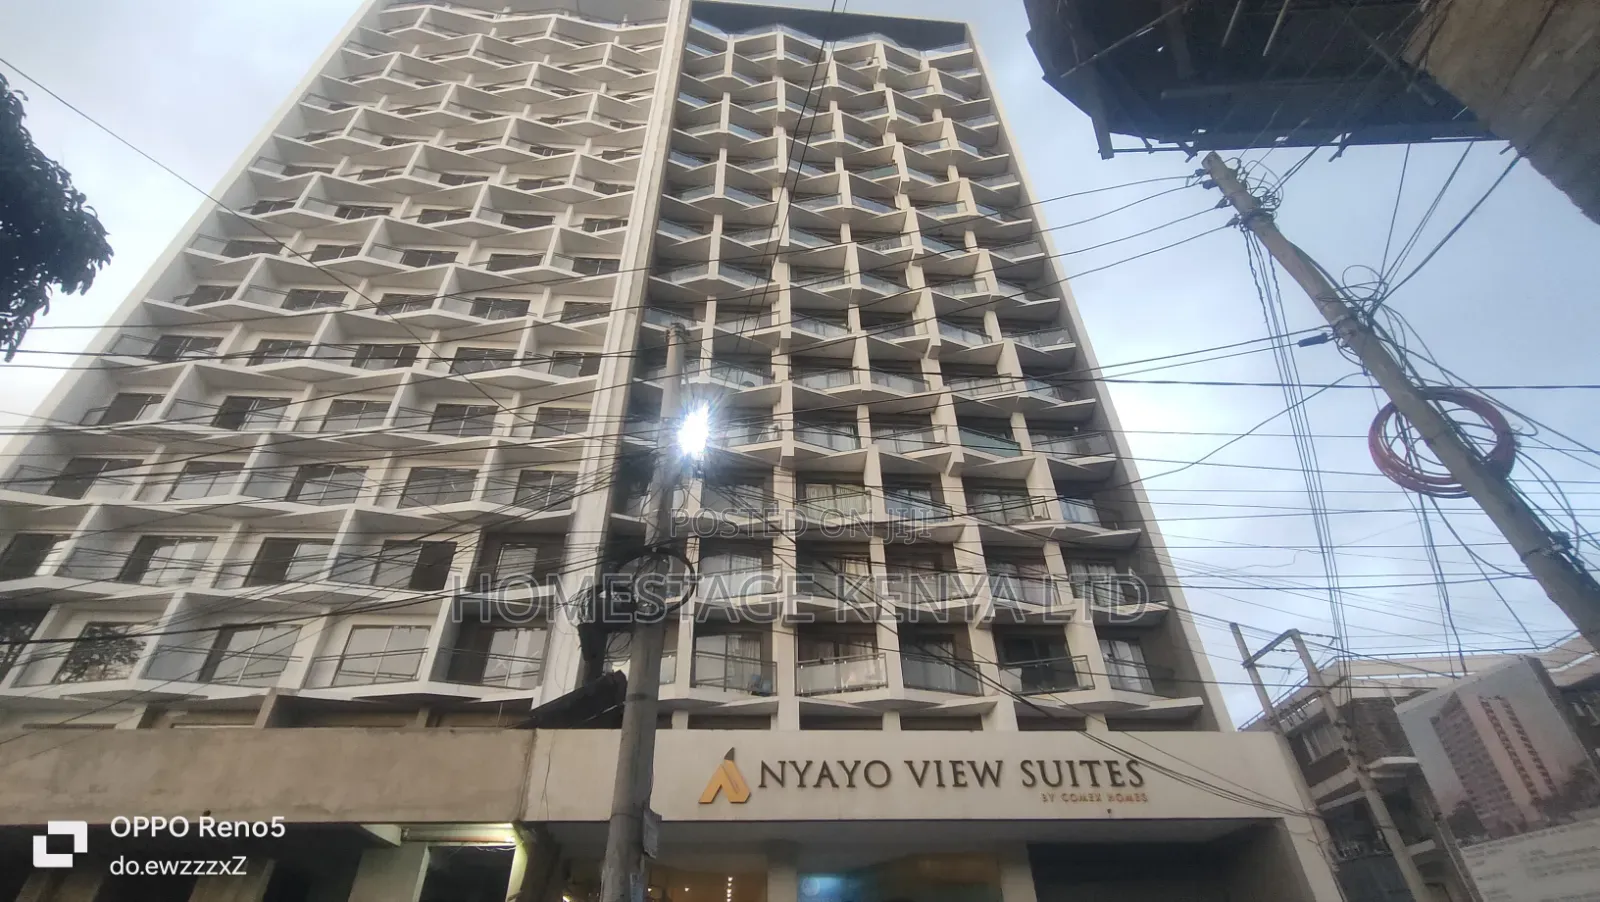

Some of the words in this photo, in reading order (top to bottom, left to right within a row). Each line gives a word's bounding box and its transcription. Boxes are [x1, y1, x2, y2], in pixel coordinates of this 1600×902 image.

[758, 760, 892, 789] NYAYO
[903, 760, 1004, 788] VIEW
[1020, 760, 1145, 788] SUITES
[1041, 793, 1055, 803] BY
[1107, 793, 1149, 803] HOMES
